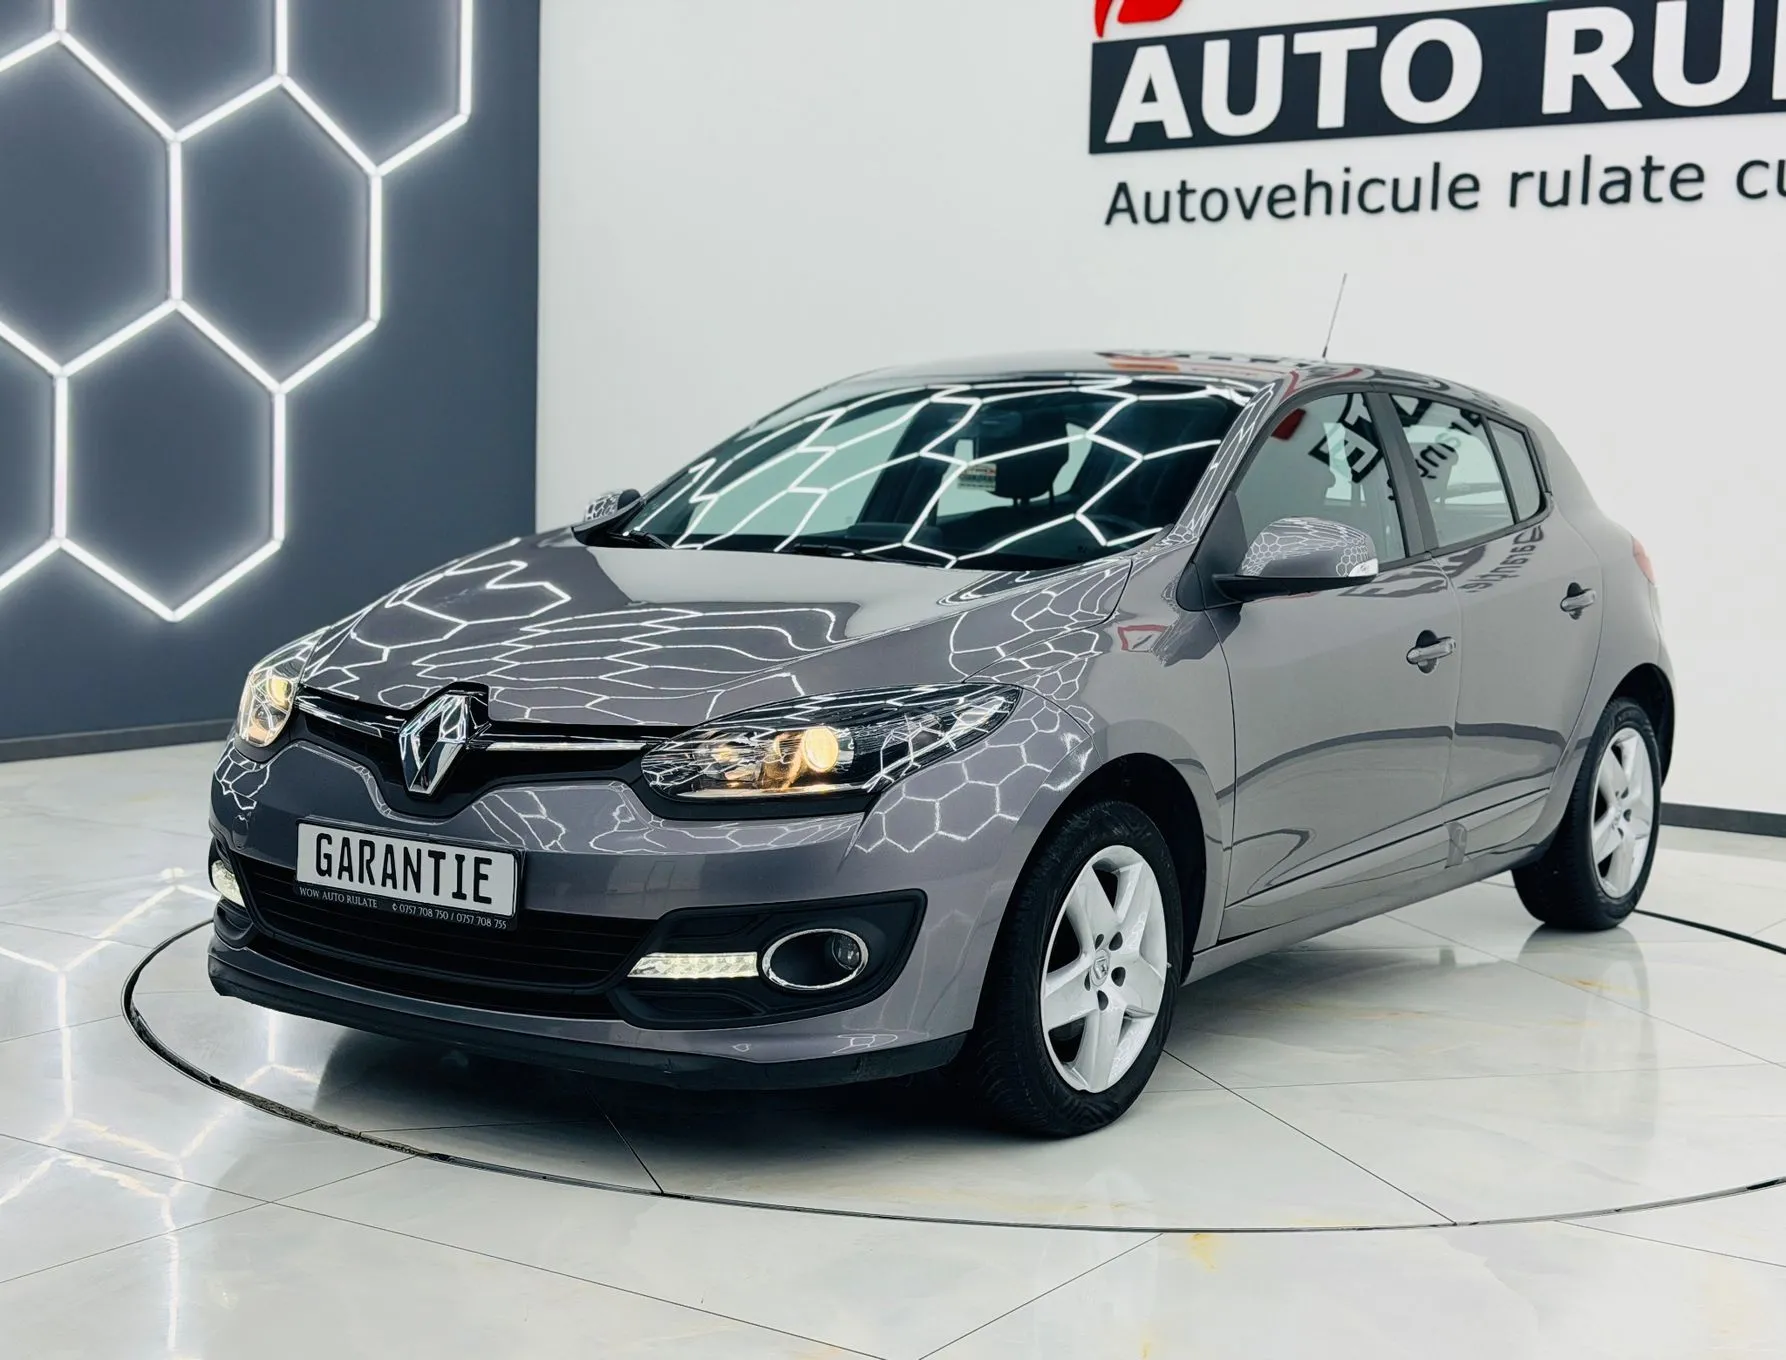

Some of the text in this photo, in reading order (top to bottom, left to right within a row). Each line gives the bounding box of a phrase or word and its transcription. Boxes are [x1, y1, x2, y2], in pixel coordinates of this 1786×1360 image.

[1104, 0, 1786, 144] AUTO RU
[1104, 162, 1481, 226] Autovehicule
[1508, 154, 1706, 209] rulate
[299, 886, 378, 909] WOW AUTO RULATE
[315, 832, 493, 905] GARANTIE
[399, 903, 417, 916] 0757
[418, 907, 433, 918] 708
[434, 909, 449, 921] 750
[456, 912, 475, 925] 0757
[476, 916, 492, 928] 708
[494, 919, 507, 930] 755
